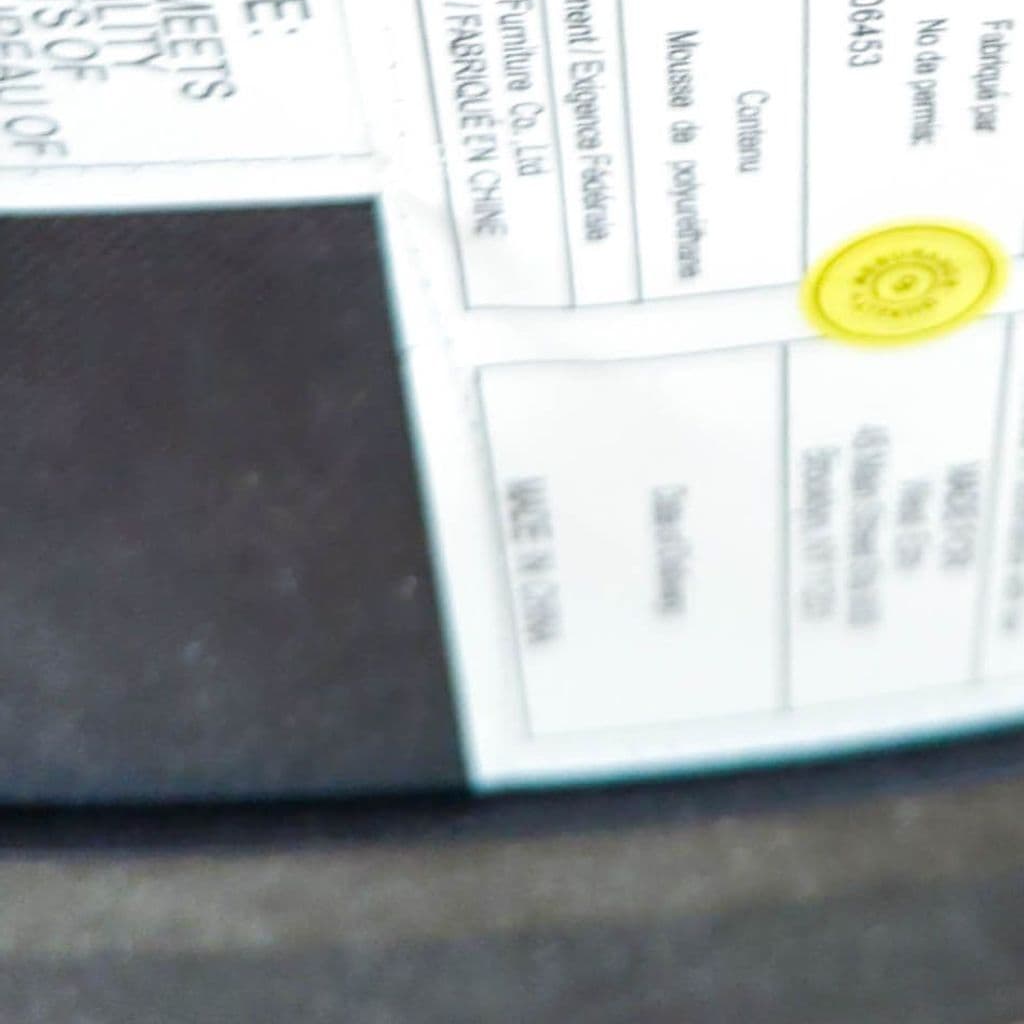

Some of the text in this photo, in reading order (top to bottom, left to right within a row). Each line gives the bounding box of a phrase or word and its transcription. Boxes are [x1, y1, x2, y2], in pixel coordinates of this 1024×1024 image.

[43, 37, 107, 81] OF
[914, 18, 948, 45] No
[970, 19, 1014, 100] Fabriqué
[443, 13, 500, 128] FABRIQUÉ
[662, 30, 701, 108] Mousse
[2, 113, 68, 157] OF
[562, 60, 605, 150] Exigence
[670, 120, 702, 144] de
[734, 90, 770, 174] Contenu
[462, 133, 499, 163] EN
[468, 170, 509, 239] CHINE
